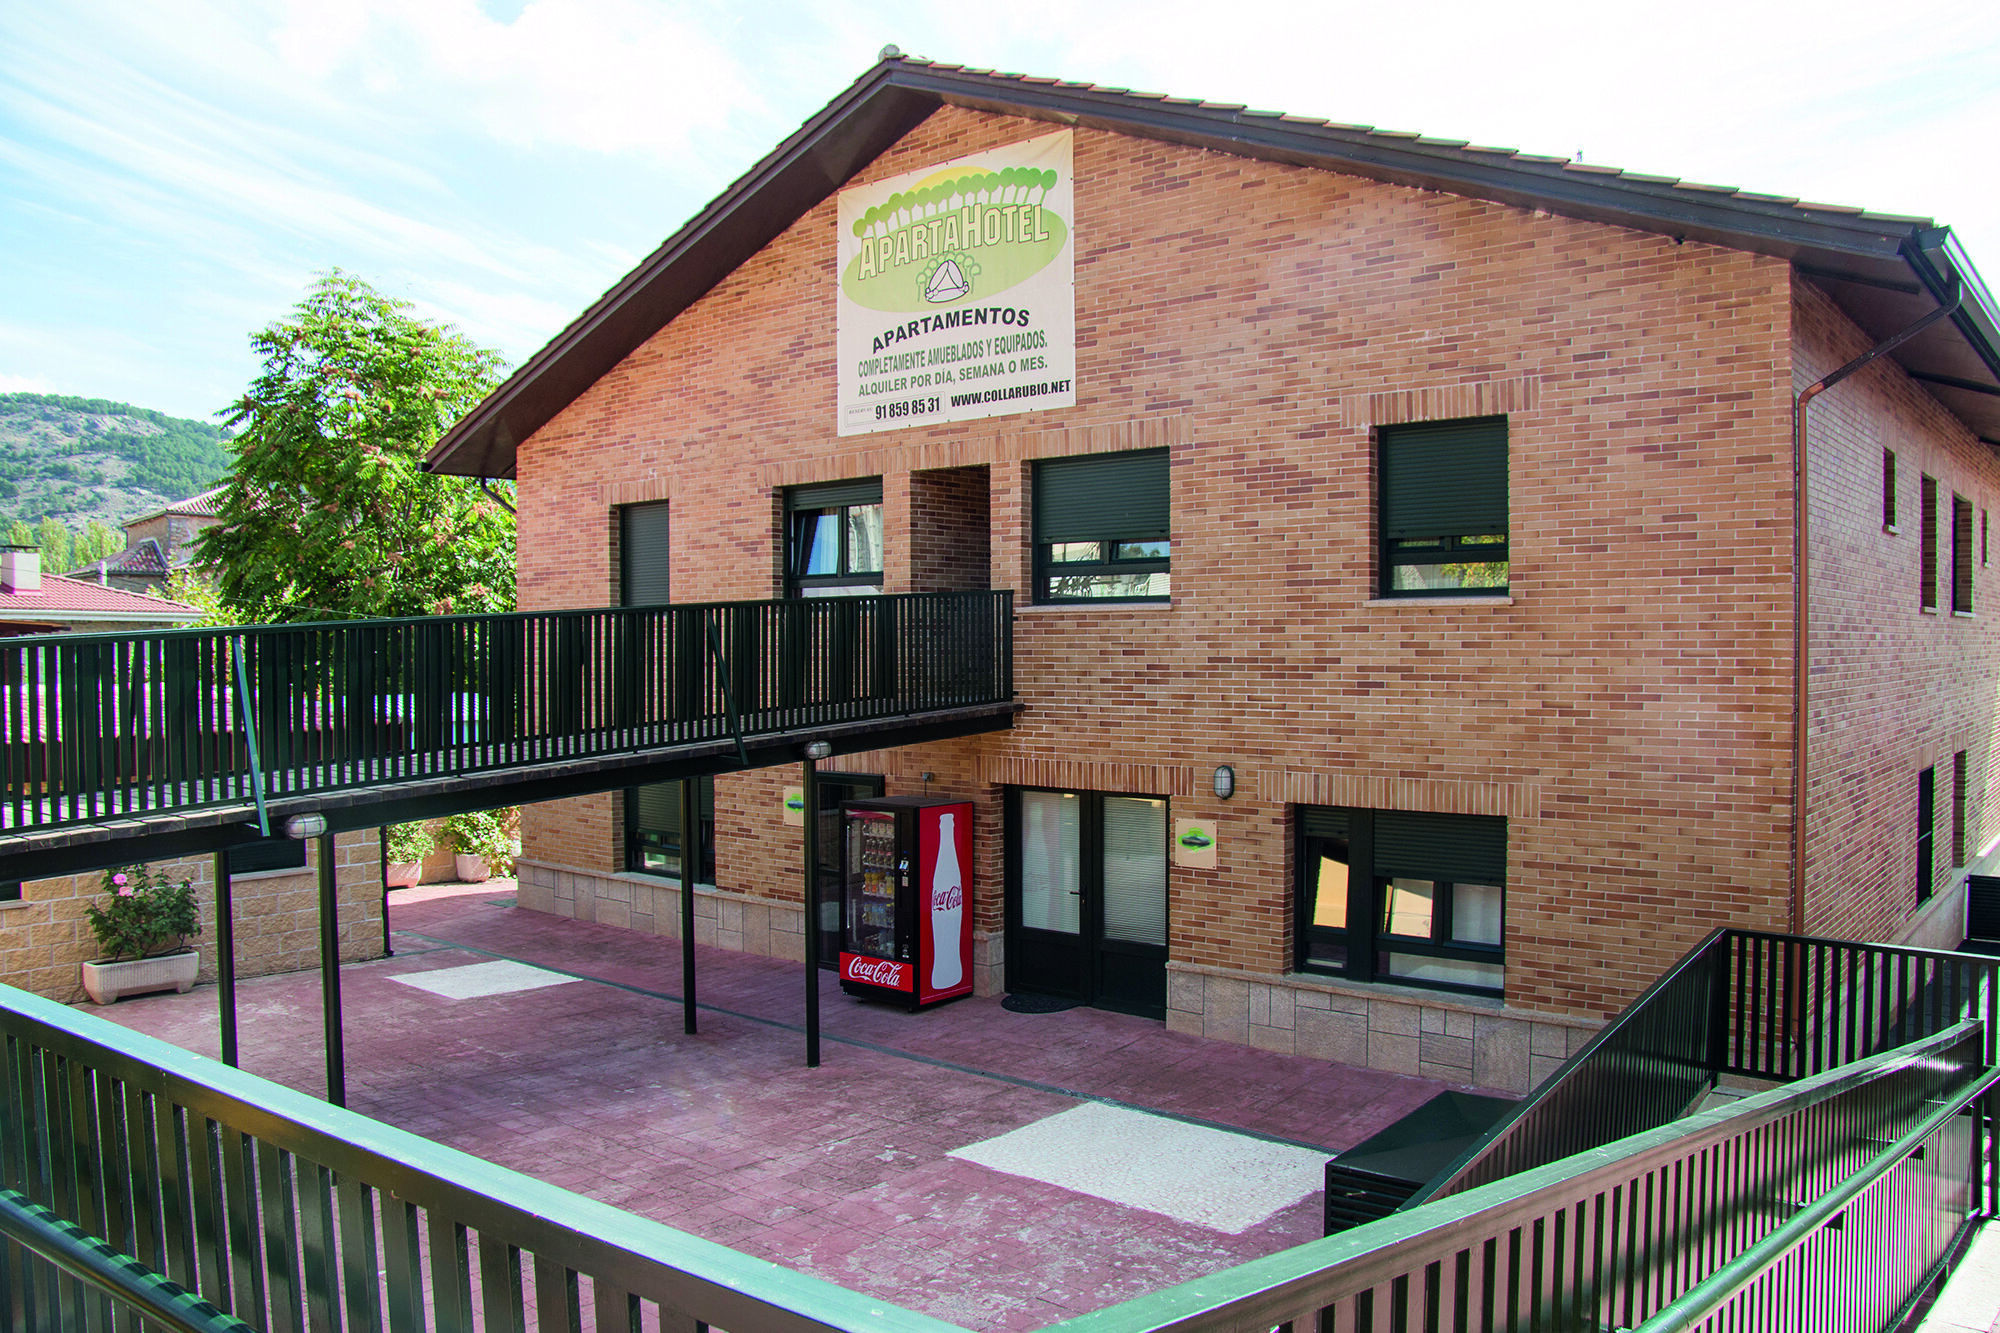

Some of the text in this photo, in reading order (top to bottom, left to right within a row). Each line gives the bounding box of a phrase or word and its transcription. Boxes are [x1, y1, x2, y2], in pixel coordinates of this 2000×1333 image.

[858, 203, 1049, 280] APARTAHOTEL
[872, 307, 1030, 354] APARTAMENTOS
[858, 329, 1048, 378] COMPLETAMENTE AMUEBLADOS Y EQUIPADOS.
[858, 355, 1048, 397] ALQUILER POR DÍA, SEMANA O MES.
[950, 379, 1071, 407] WWW.COLLARUBIO.NET
[875, 404, 887, 420] 91
[888, 400, 909, 418] 859
[911, 398, 925, 415] 85
[927, 396, 940, 413] 31
[849, 956, 903, 987] Coca-Cola
